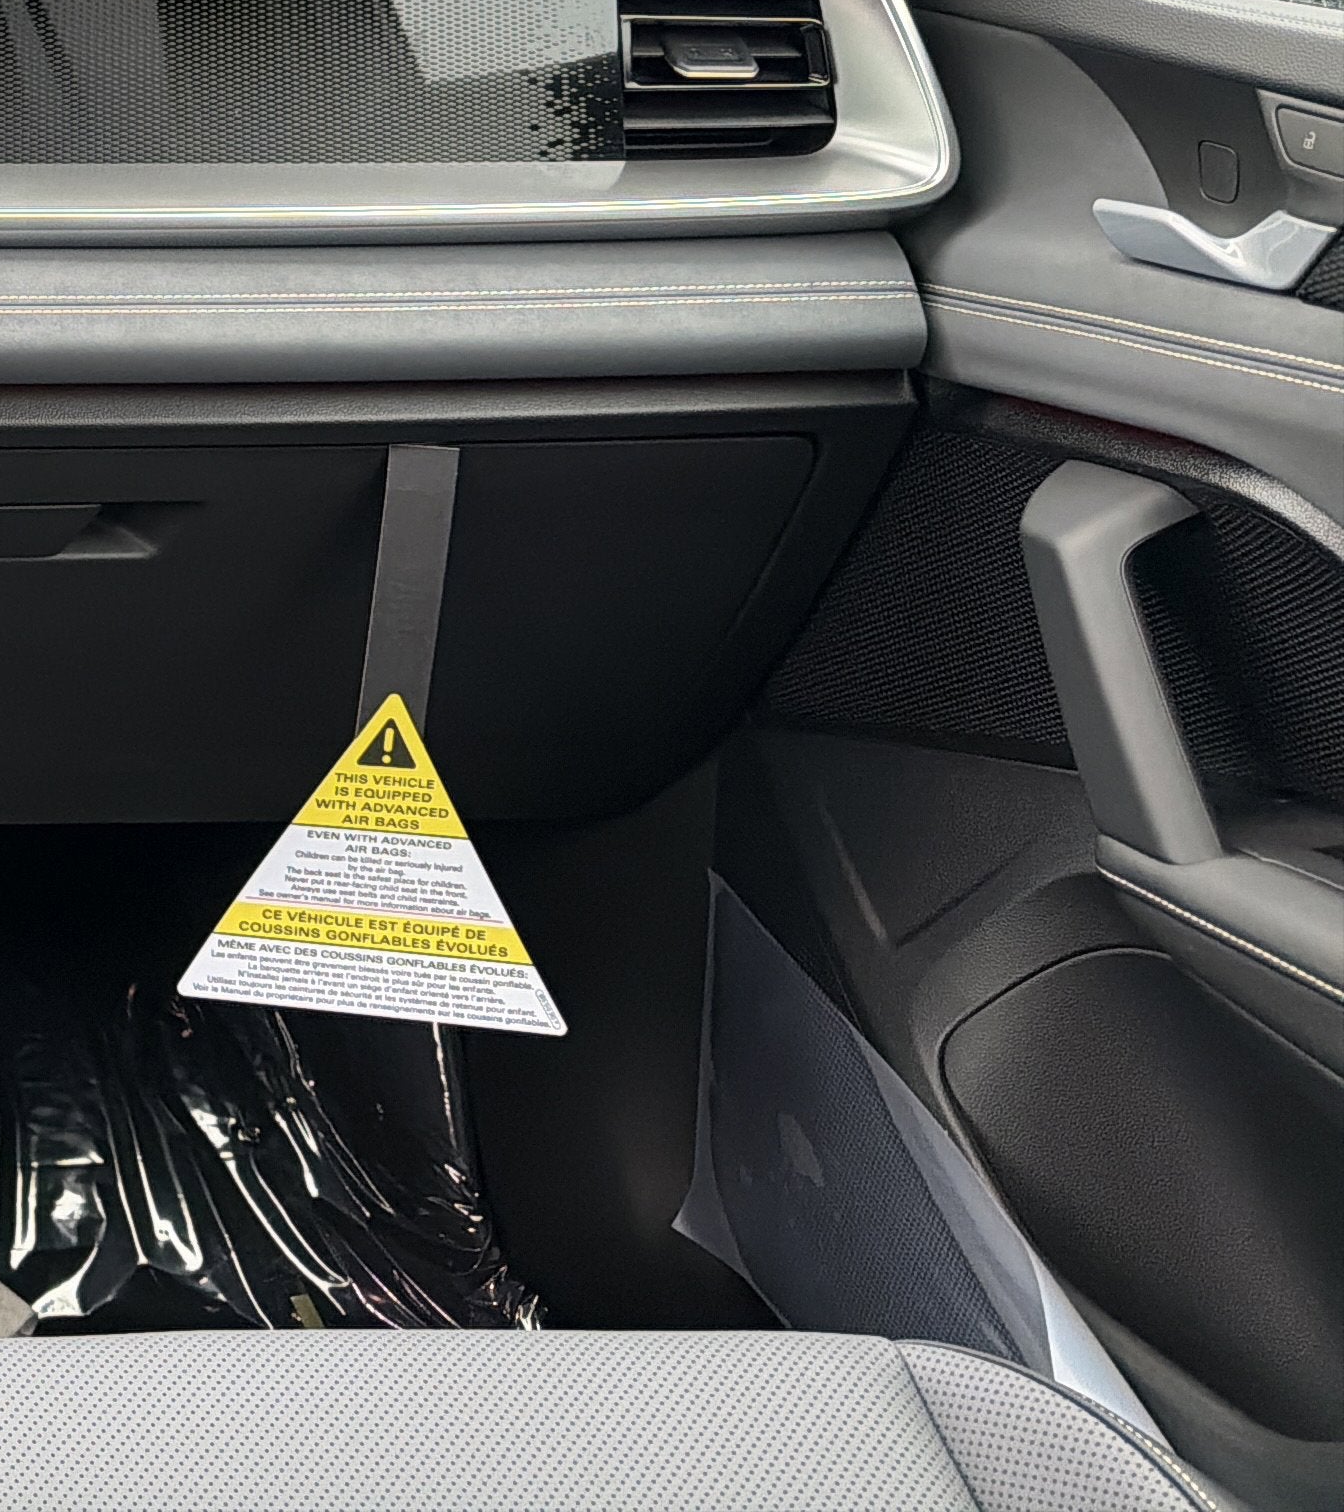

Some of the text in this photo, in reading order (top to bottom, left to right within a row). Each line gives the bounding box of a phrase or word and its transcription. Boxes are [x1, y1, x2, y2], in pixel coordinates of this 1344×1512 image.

[334, 772, 434, 789] THIS VEHICLE
[334, 785, 432, 802] IS EQUIPPED
[315, 798, 449, 818] WITH ADVANCED
[341, 814, 419, 829] AIR BAGS
[306, 830, 451, 849] EVEN WITH ADVANCED
[344, 844, 411, 857] AIR BAGS:
[261, 908, 486, 940] CE VÉHICULE EST ÉQUIPÉ DE
[238, 920, 508, 957] COUSSINS GONFLABLES ÉVOLUÉS
[217, 939, 528, 979] MÊME AVEC DES COUSSINS GONFLABLES ÉVOLUÉS:
